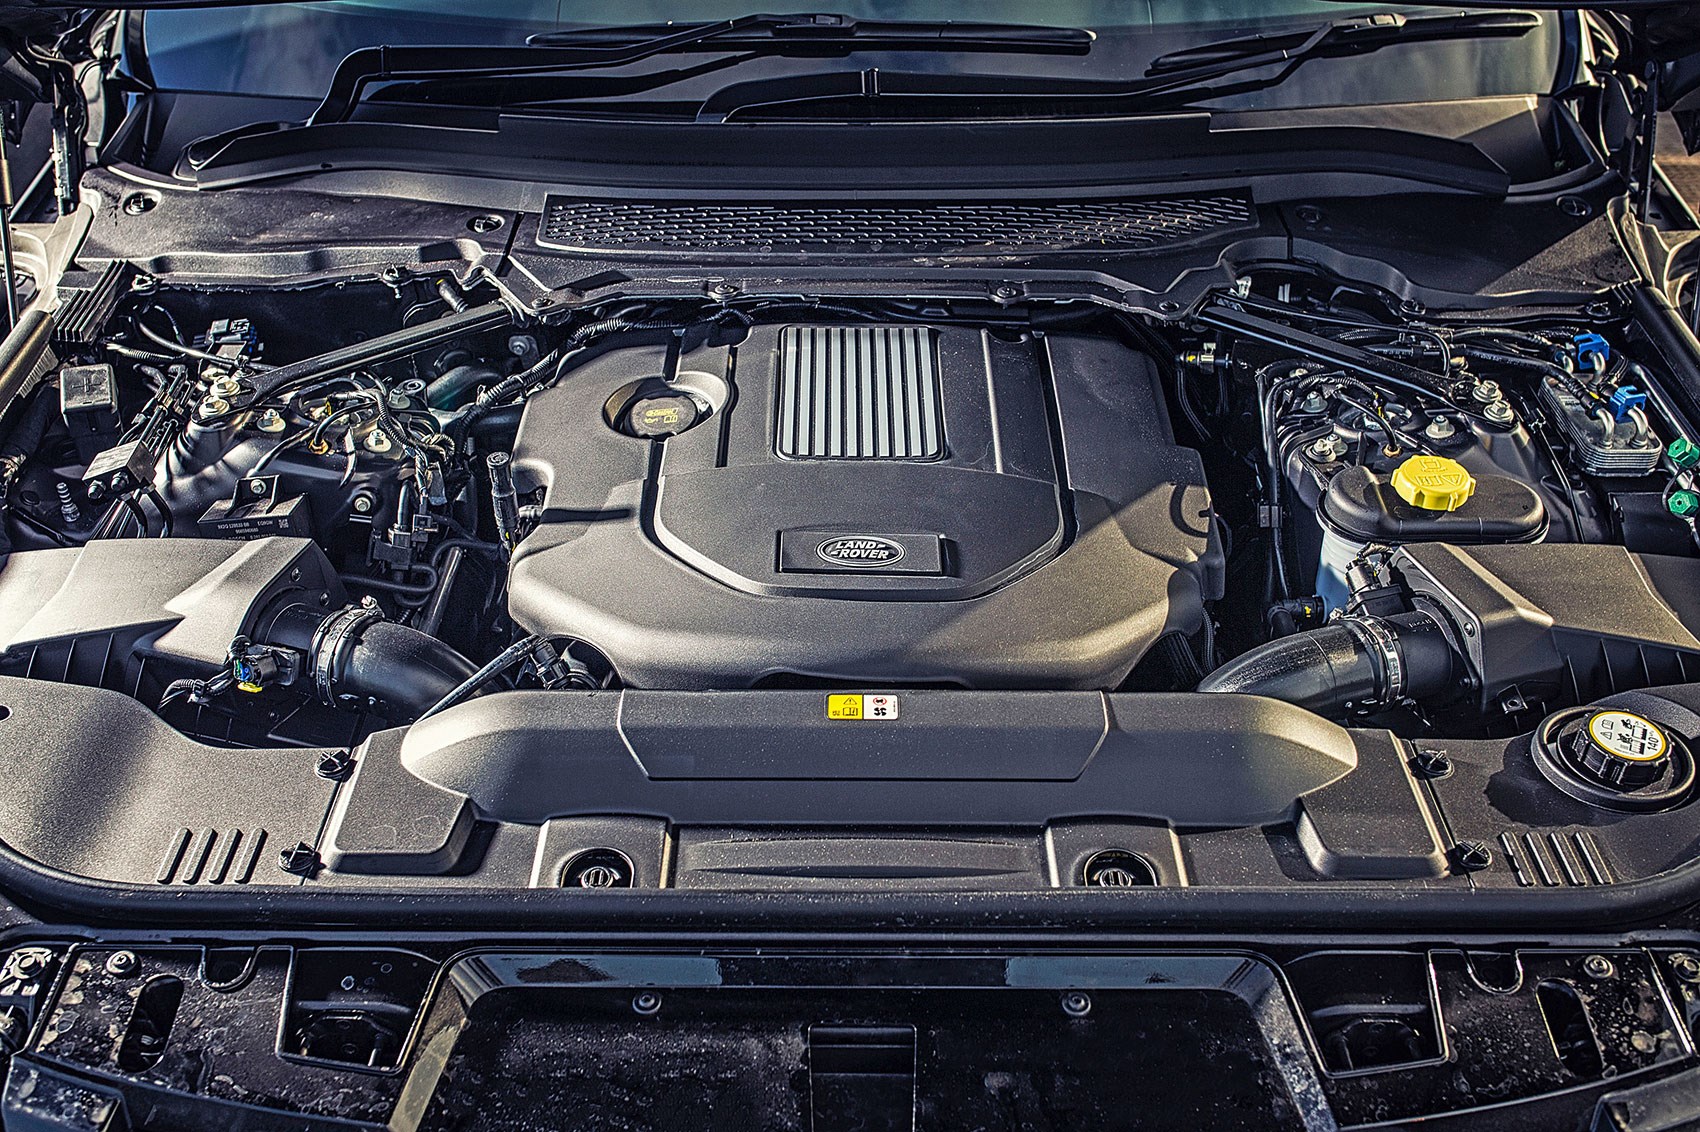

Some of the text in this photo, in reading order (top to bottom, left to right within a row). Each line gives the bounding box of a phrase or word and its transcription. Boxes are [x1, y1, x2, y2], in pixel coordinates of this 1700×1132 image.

[836, 541, 877, 549] LAND
[839, 549, 889, 559] ROVER
[1647, 737, 1659, 751] 140
